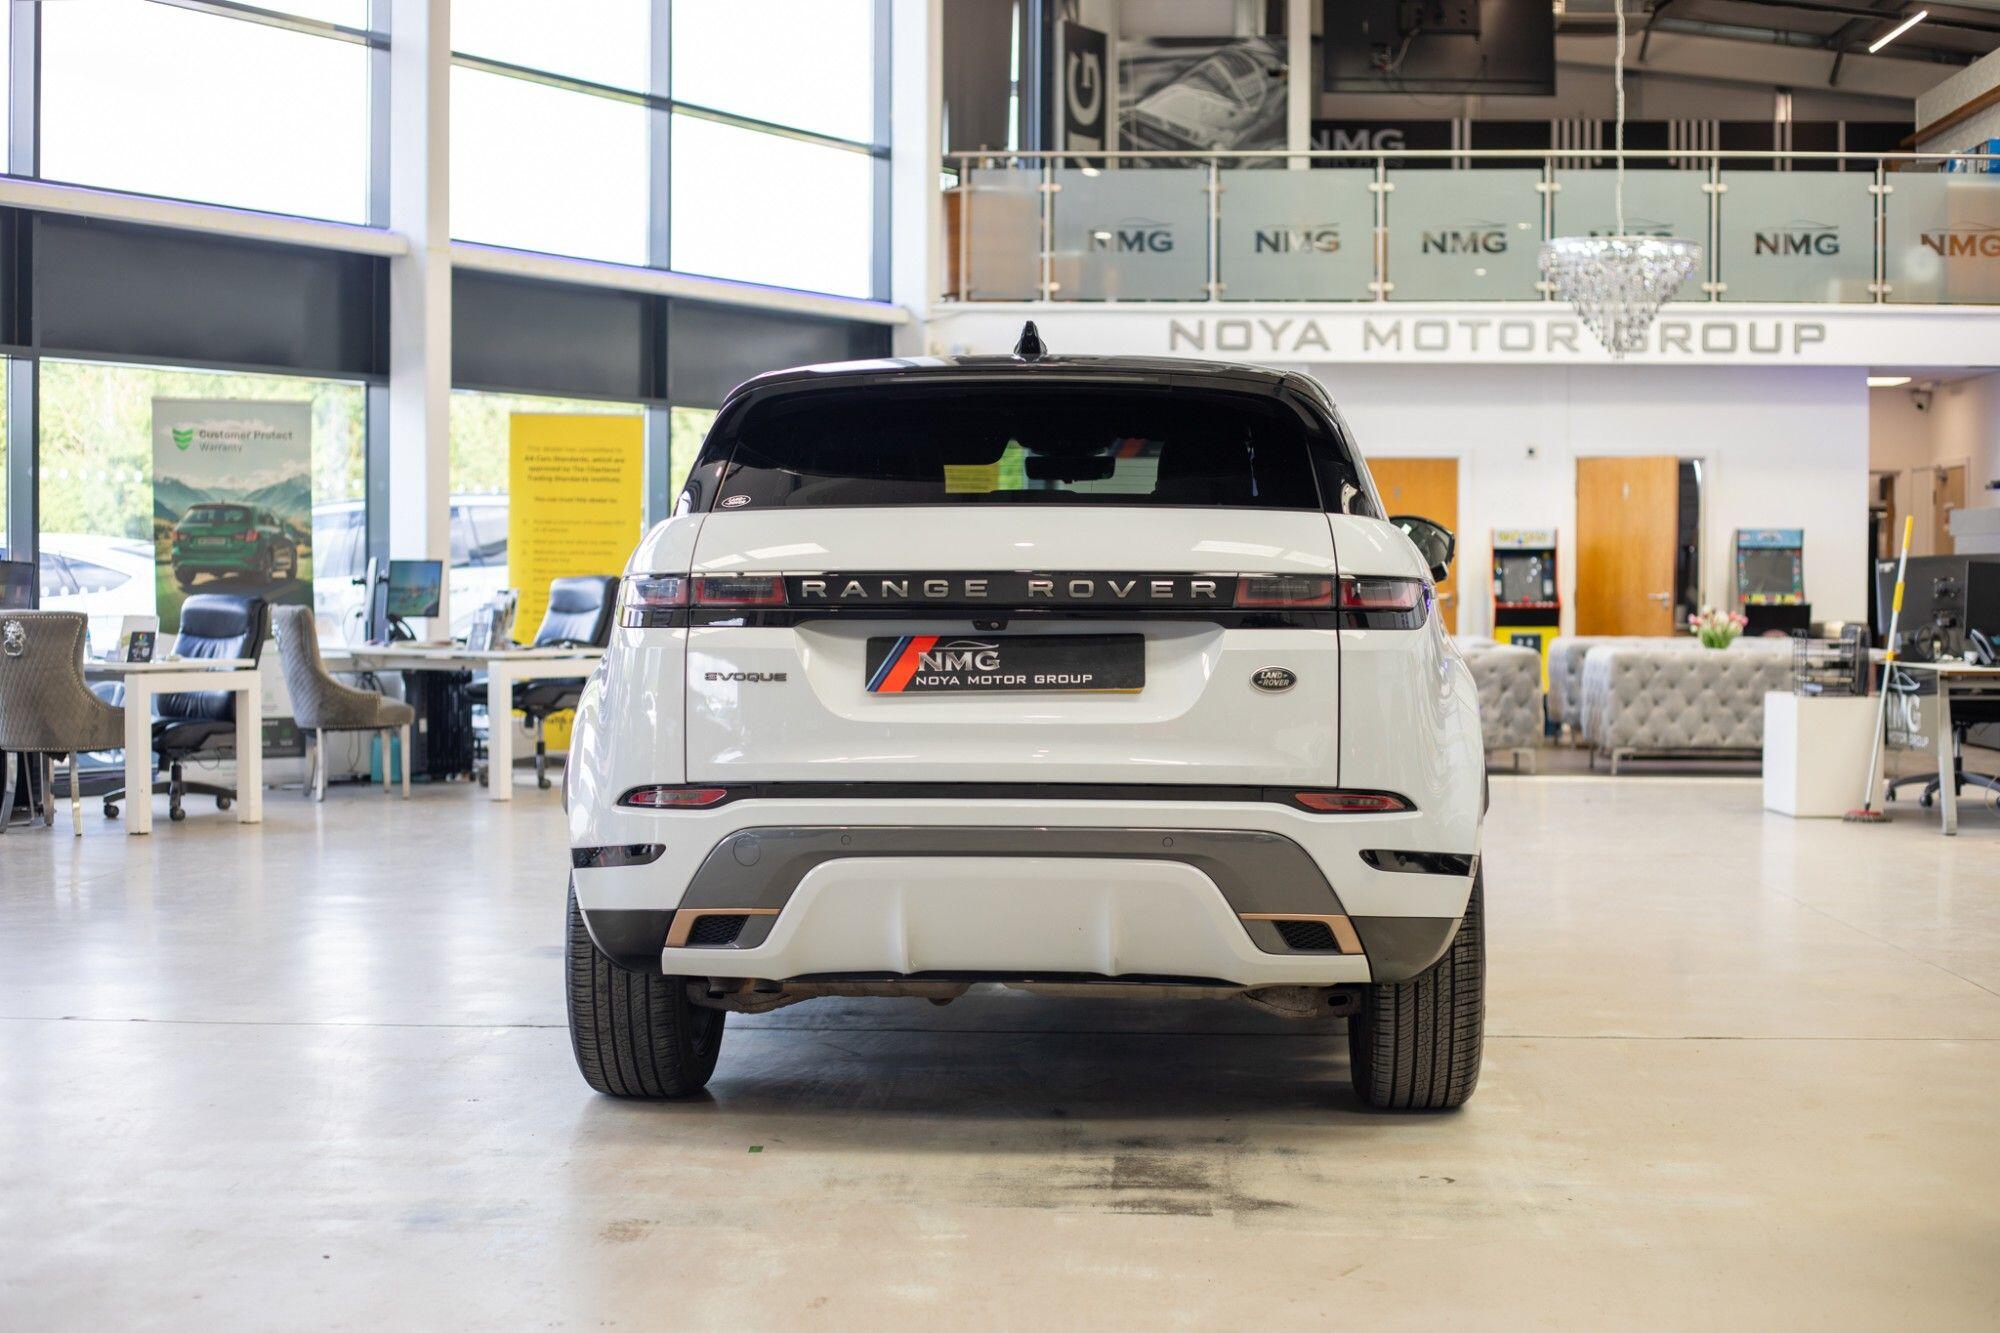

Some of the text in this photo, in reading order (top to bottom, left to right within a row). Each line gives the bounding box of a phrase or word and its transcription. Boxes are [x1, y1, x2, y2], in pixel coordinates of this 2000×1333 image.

[1421, 231, 1508, 254] NMG
[1754, 232, 1840, 256] NMG
[1169, 319, 1331, 351] NOYA
[1363, 319, 1580, 352] MOTOR
[199, 429, 293, 441] Customer Protect
[199, 443, 243, 453] Warranty
[802, 580, 1217, 598] RANGE ROVER
[917, 651, 1000, 672] NMG
[704, 672, 787, 682] EVOQUE
[916, 674, 1093, 685] NOYA MOTOR GROUP
